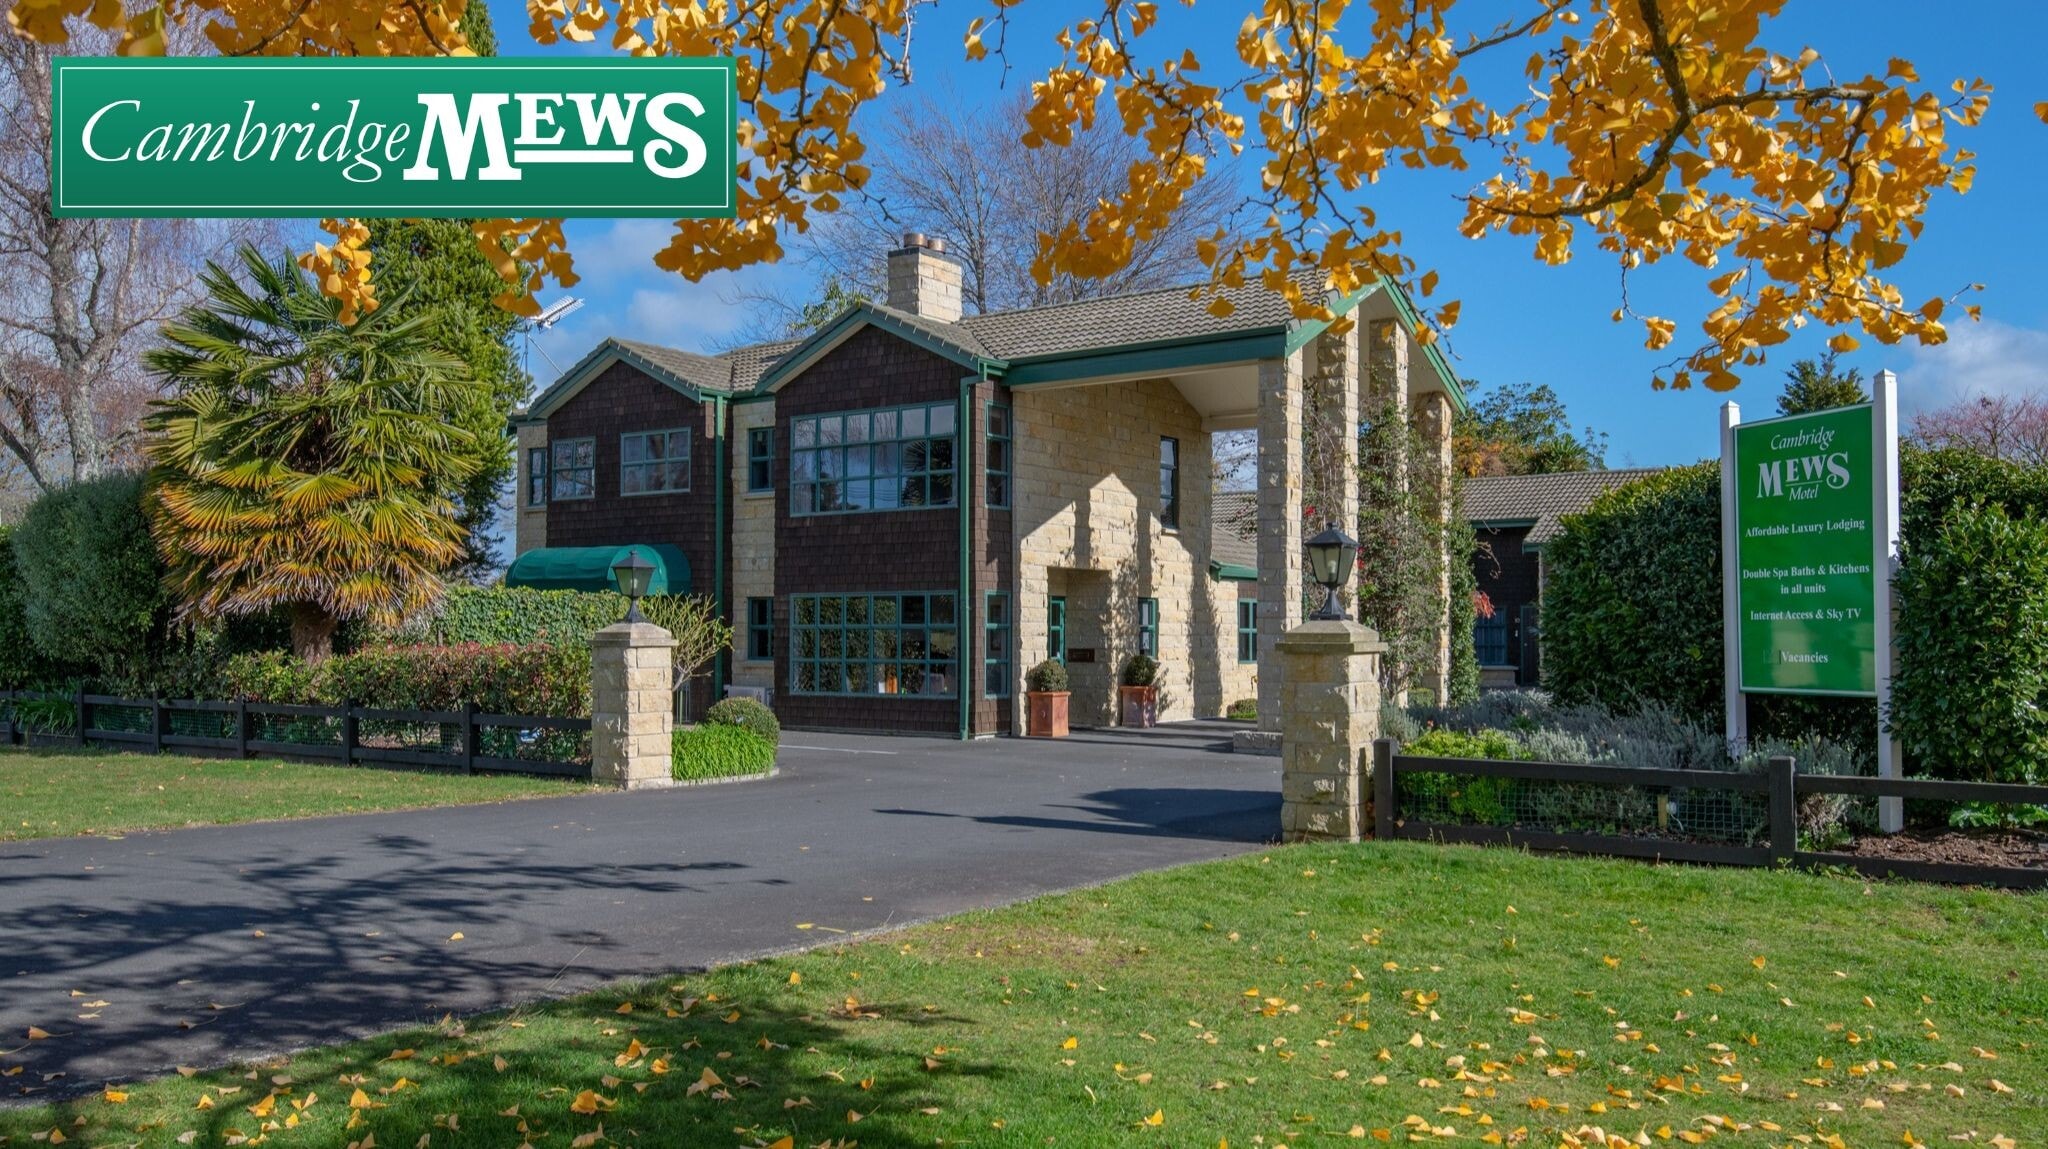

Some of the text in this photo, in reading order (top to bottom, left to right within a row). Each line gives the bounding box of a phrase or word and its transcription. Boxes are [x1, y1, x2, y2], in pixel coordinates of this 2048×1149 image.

[1770, 426, 1835, 451] Cambridge
[1757, 451, 1850, 498] MEWS
[1789, 484, 1819, 501] Motel
[1745, 518, 1865, 537] Affordable Luxury Lodging
[1743, 563, 1870, 580] Double Spa Baths & Kitchens
[1780, 582, 1826, 594] in all units
[1750, 608, 1861, 621] Internet Access & Sky TV
[1781, 650, 1828, 663] Vacancies
